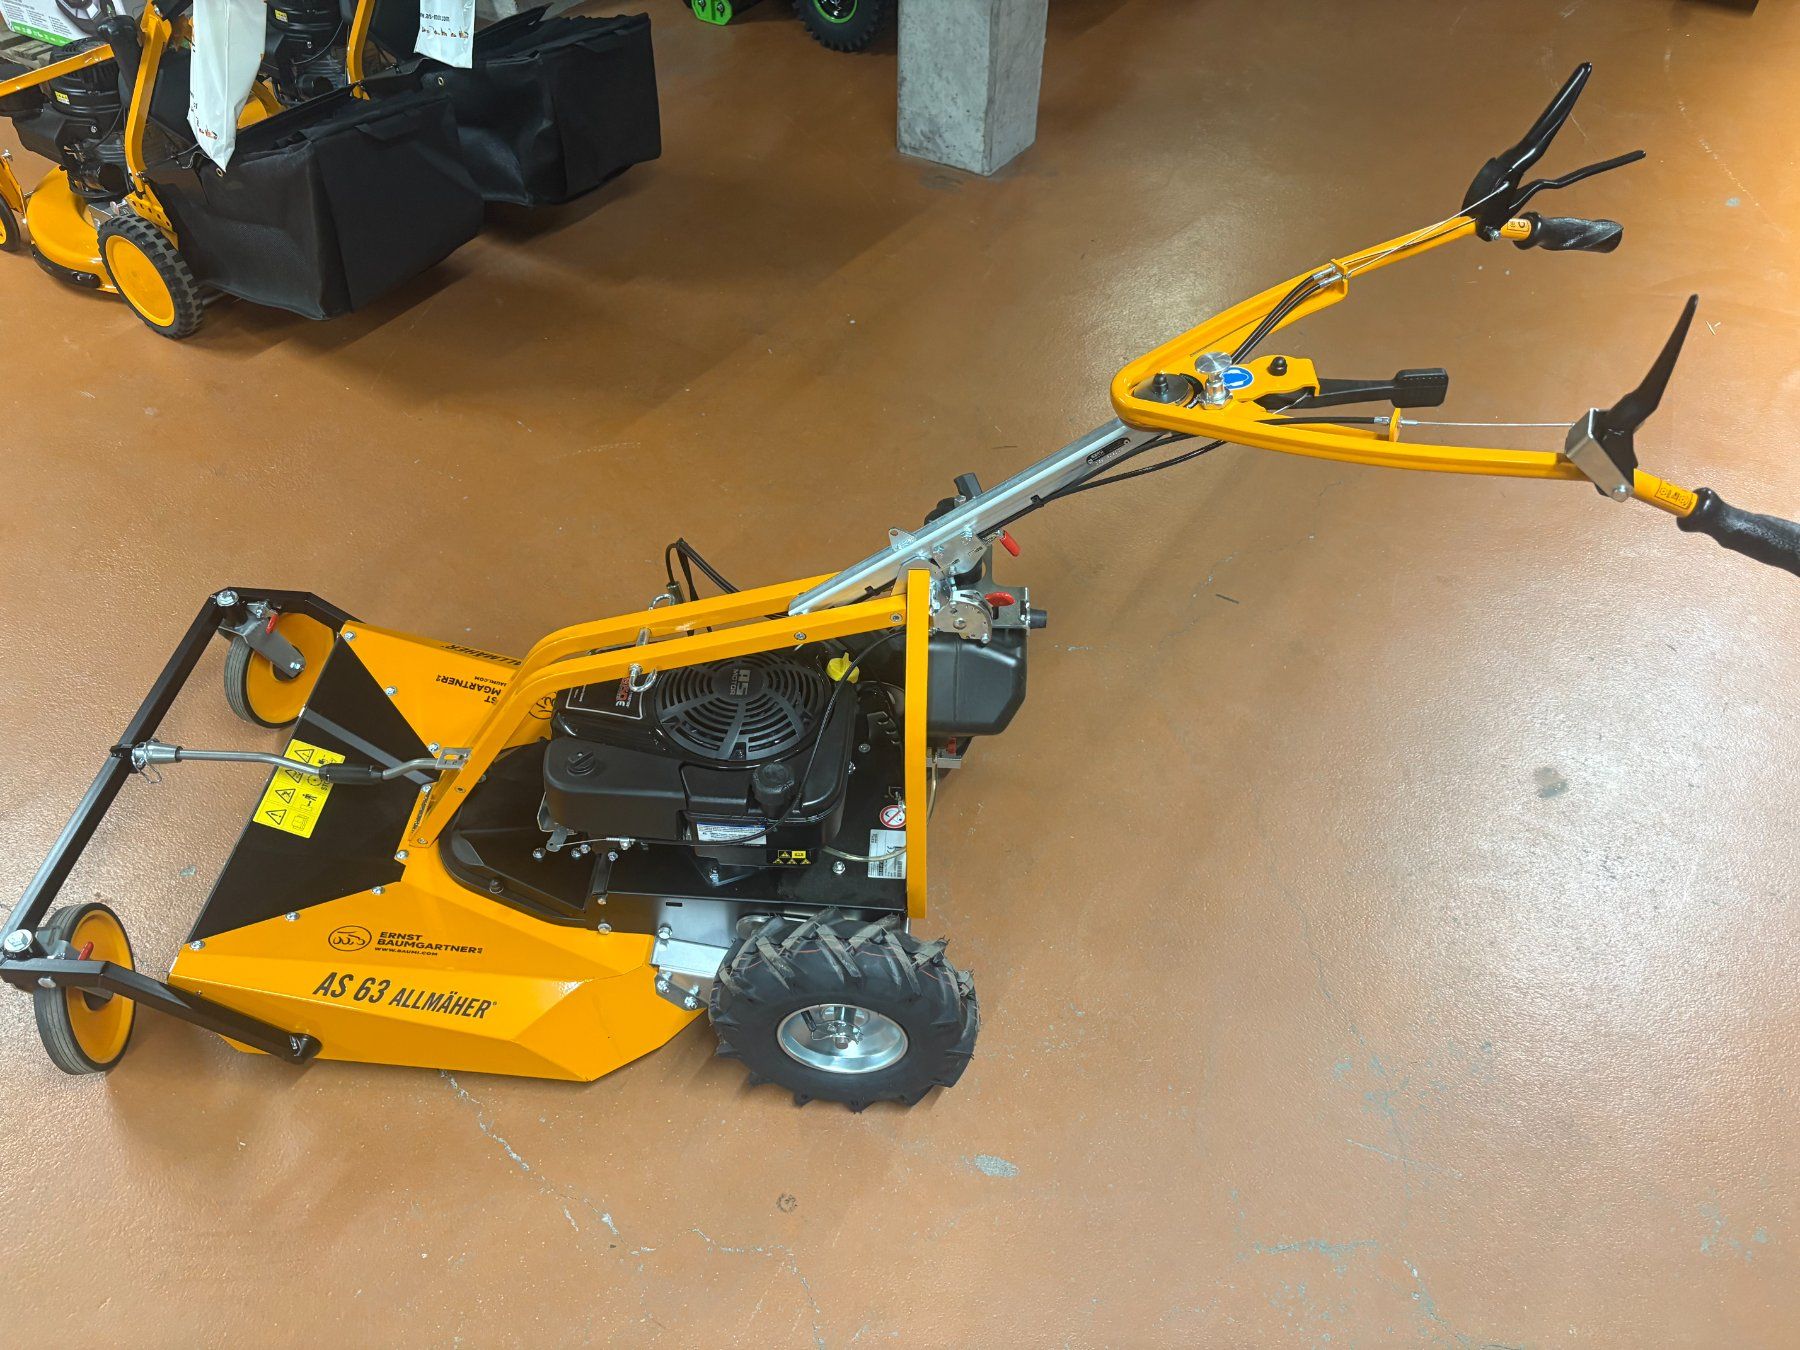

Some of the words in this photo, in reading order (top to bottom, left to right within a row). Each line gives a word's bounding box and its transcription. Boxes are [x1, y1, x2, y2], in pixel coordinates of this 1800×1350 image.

[729, 668, 739, 696] MOTOR
[380, 931, 423, 942] ERNST
[374, 946, 438, 957] WWW.BAUMI.COM
[377, 938, 477, 954] BAUMGARTNER
[312, 971, 354, 999] AS
[353, 976, 391, 1004] 63
